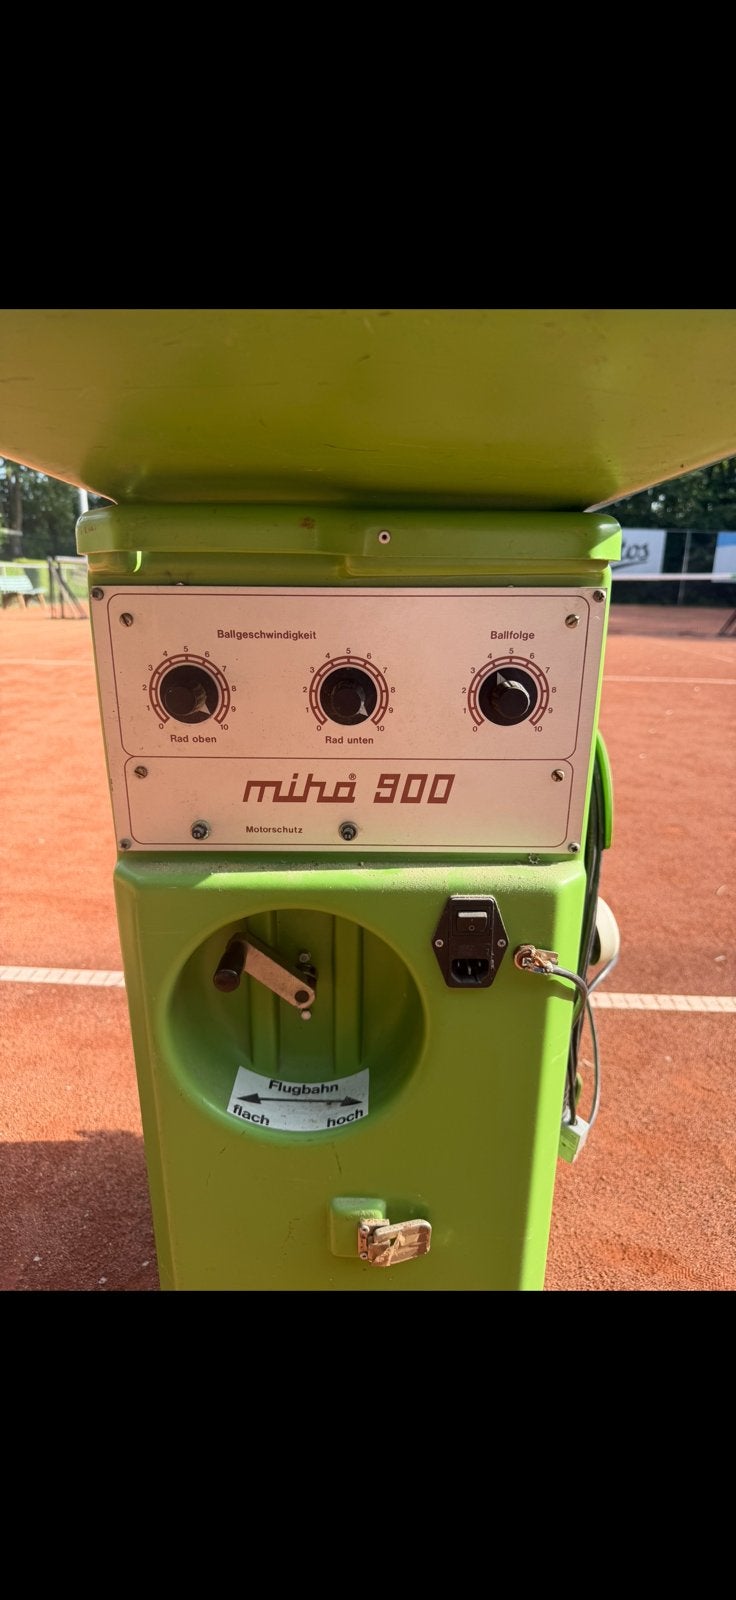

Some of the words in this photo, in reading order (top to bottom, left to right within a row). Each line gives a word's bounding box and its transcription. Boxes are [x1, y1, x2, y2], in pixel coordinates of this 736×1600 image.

[216, 629, 317, 642] Ballgeschwindigkeit
[490, 630, 535, 641] Ballfolge
[170, 734, 189, 743] Rad
[192, 735, 217, 743] oben
[325, 736, 344, 744] Rad
[347, 736, 374, 745] unten
[373, 773, 456, 804] 900
[245, 825, 303, 834] Motorschutz
[268, 1079, 339, 1096] Flugbahn
[232, 1104, 271, 1126] flach
[326, 1108, 364, 1128] hoch
